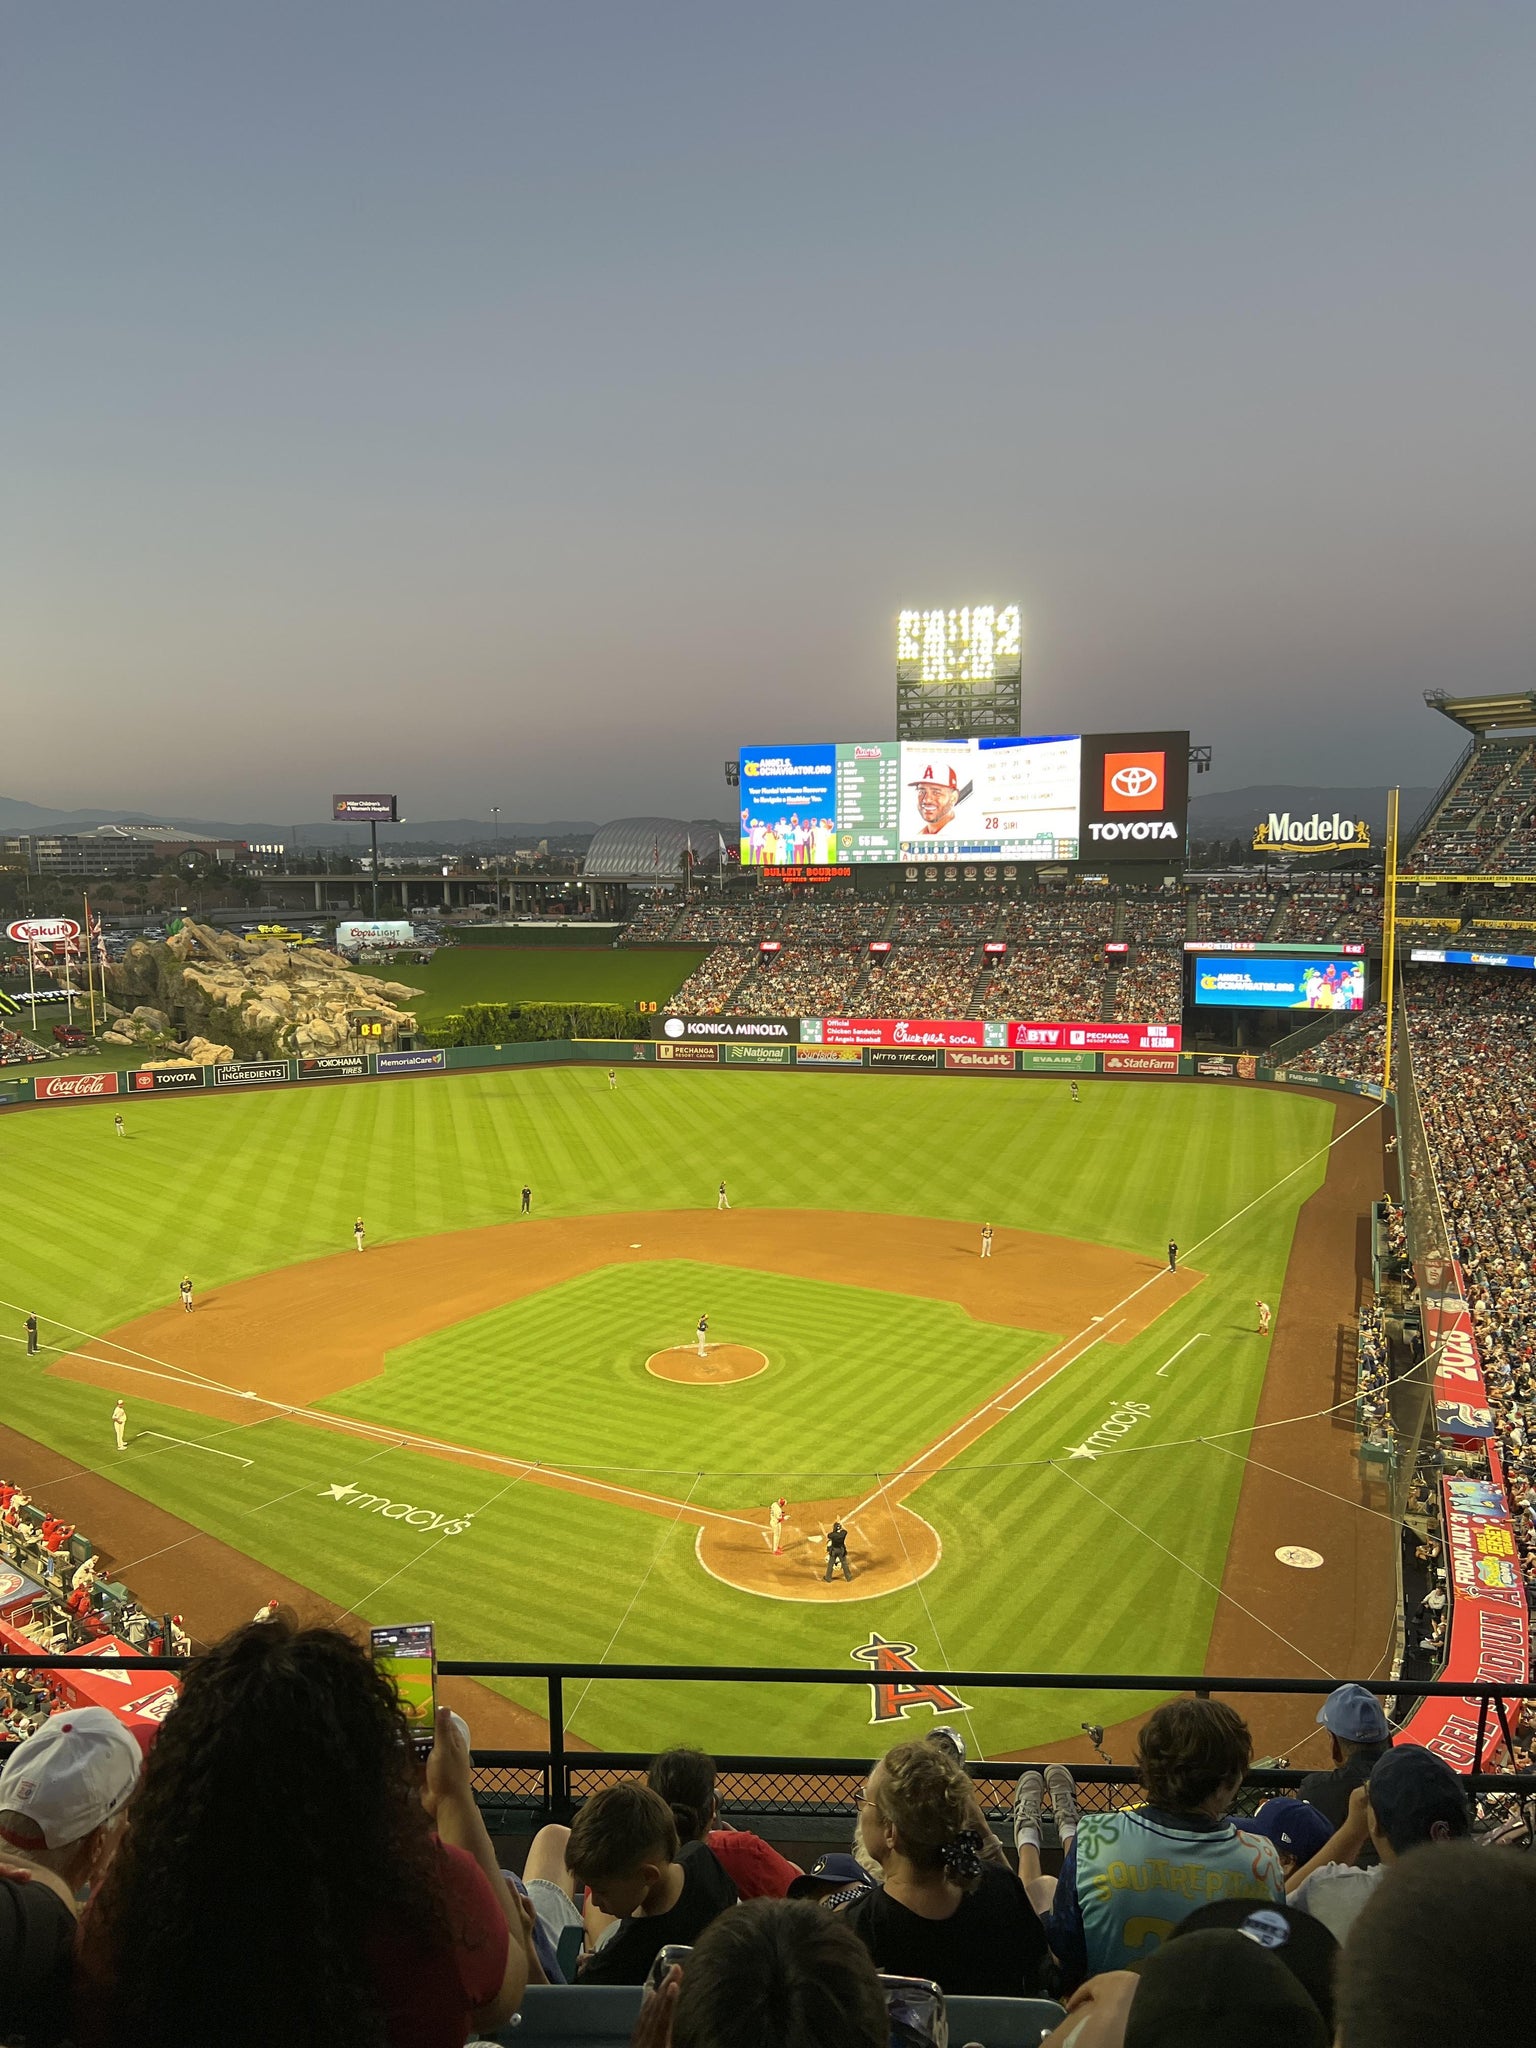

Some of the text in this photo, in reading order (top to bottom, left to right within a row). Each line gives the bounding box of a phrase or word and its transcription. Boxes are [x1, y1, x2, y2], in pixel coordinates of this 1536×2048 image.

[923, 765, 934, 779] A
[985, 818, 1018, 830] 28 SIRI
[1268, 812, 1355, 842] Modelo
[1088, 822, 1178, 840] TOYOTA
[806, 867, 851, 876] BOURBON
[22, 925, 67, 936] Yakult
[351, 928, 376, 937] Coors
[687, 1023, 788, 1036] KONICA MINOLTA
[1086, 1032, 1129, 1040] PECHANGA
[743, 1047, 784, 1058] National
[899, 1053, 935, 1062] TIRE.COM
[317, 1057, 362, 1068] YOKOHAMA
[381, 1056, 432, 1067] MemorialCare
[950, 1053, 1009, 1065] Yakult
[221, 1065, 242, 1073] JUST
[342, 1066, 362, 1075] TIRES
[156, 1073, 197, 1083] TOYOTA
[222, 1069, 281, 1081] INGREDIENTS
[1289, 1073, 1318, 1083] FMB.com
[46, 1075, 104, 1096] Coca-Cola
[1484, 1524, 1505, 1557] JERSEY
[1450, 1513, 1476, 1586] FRIDAY, JULY 31
